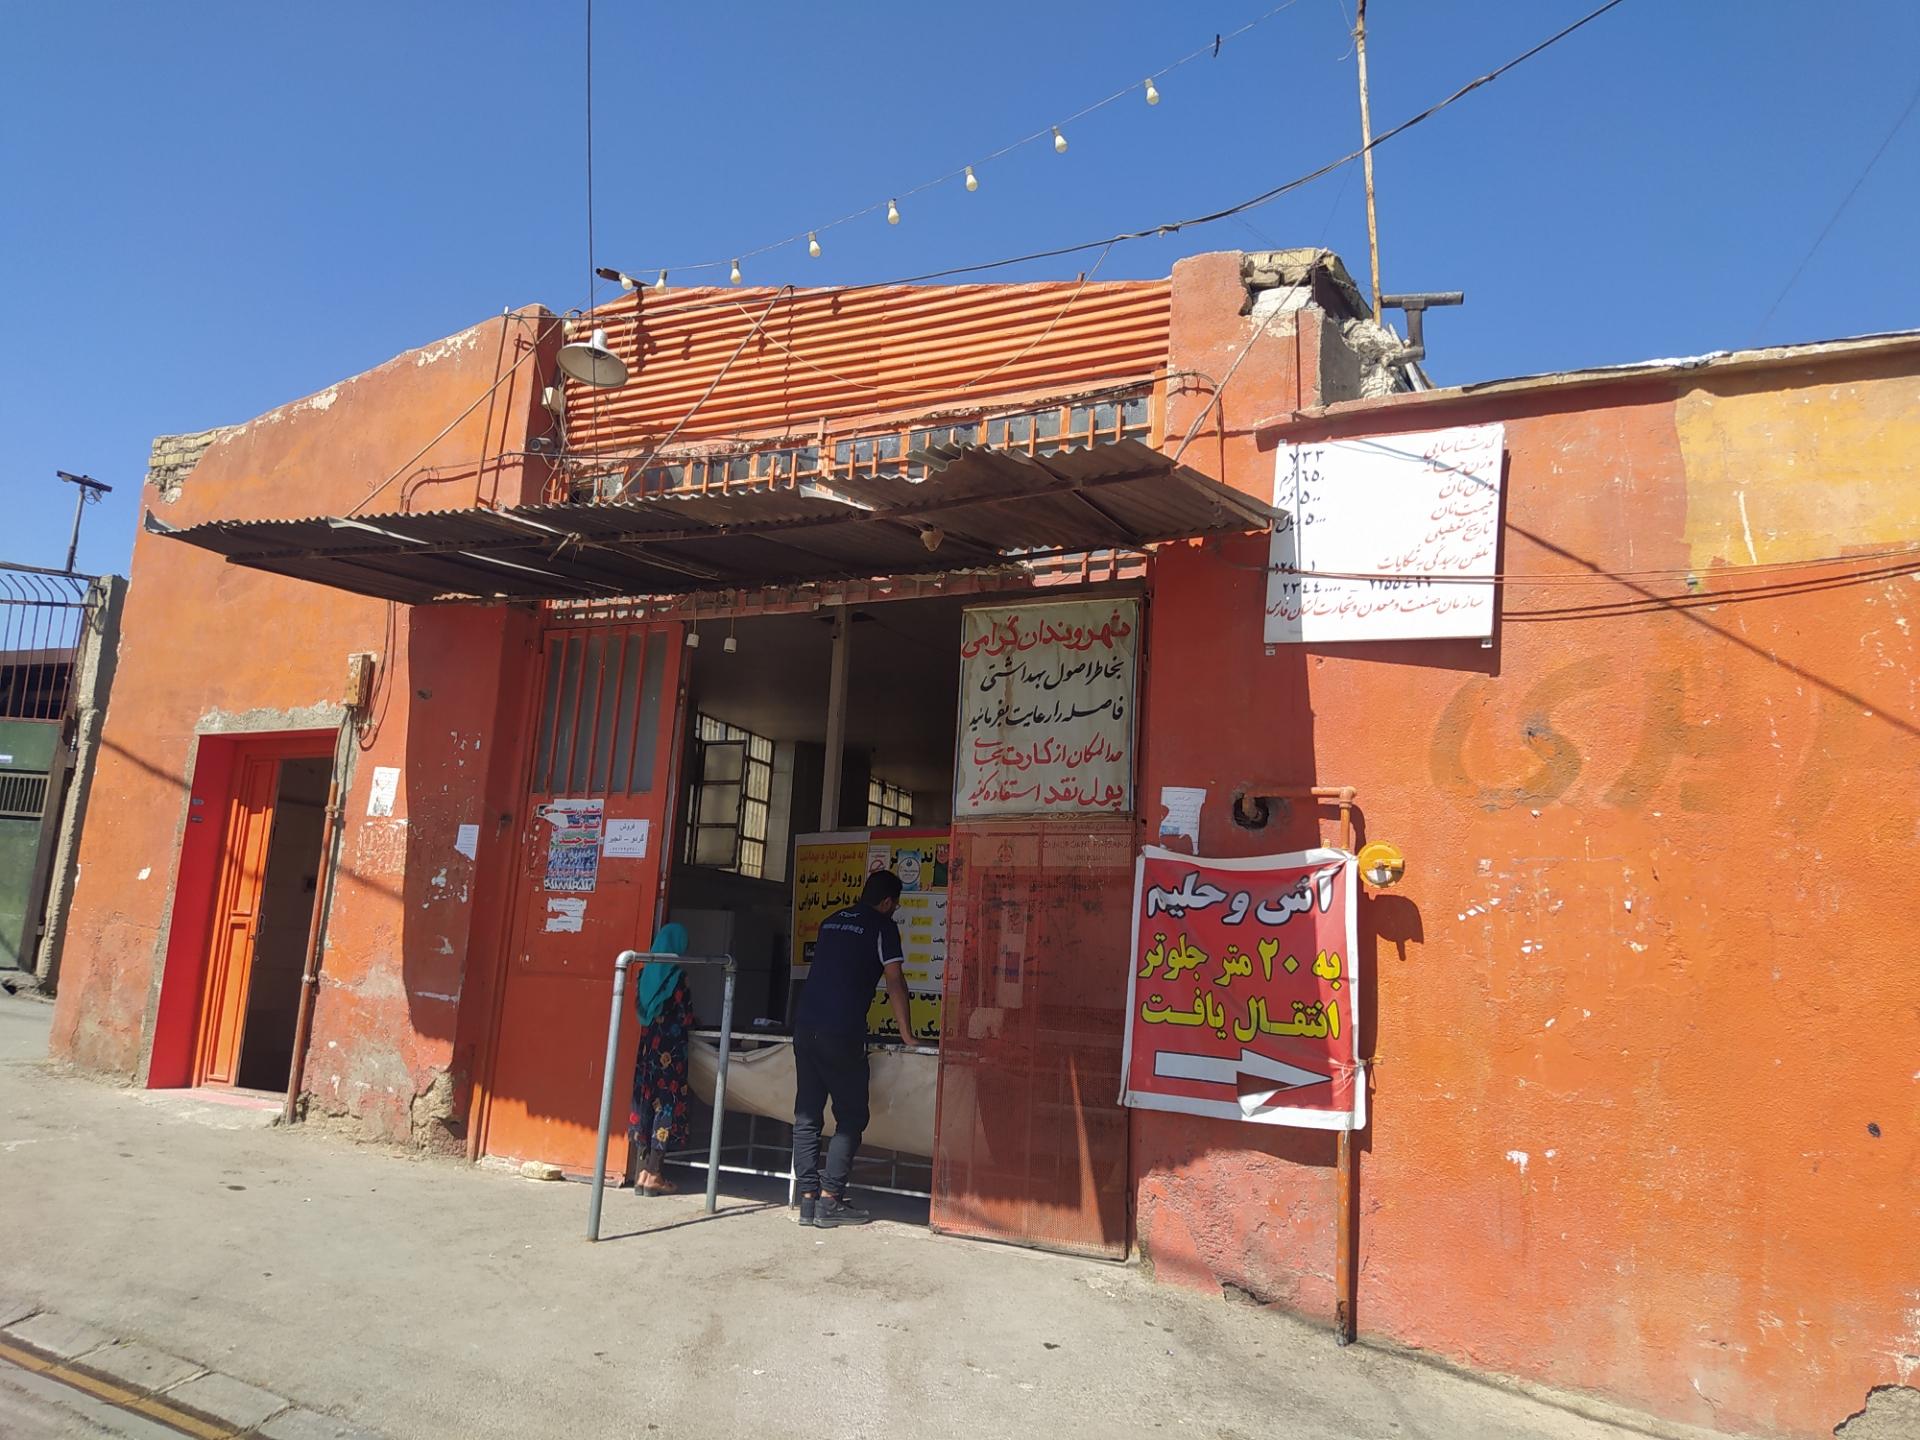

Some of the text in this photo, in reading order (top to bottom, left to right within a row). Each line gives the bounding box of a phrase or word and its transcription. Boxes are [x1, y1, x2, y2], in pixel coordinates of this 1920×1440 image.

[1424, 433, 1484, 459] شناسایی
[1464, 456, 1493, 475] وزن
[1439, 479, 1462, 498] نان
[1275, 513, 1300, 533] ریال
[1431, 501, 1494, 520] قیمت نان
[1425, 518, 1494, 543] تاریخ تعطیلی
[1377, 544, 1421, 572] شکایات
[1424, 545, 1460, 571] رسیدگی
[1458, 542, 1493, 569] تلفن
[1266, 600, 1288, 618] فارس
[1287, 596, 1318, 621] استان
[1313, 596, 1354, 620] تجارت
[1357, 599, 1395, 617] معدن
[1400, 595, 1440, 612] صنعت
[1437, 595, 1483, 614] سازمان
[962, 608, 1131, 658] شهروندان گرامی
[980, 656, 1123, 691] بخاطر اصول بهداشتی
[1007, 705, 1053, 726] رعایت
[1063, 696, 1123, 721] فاصله
[1001, 737, 1054, 770] کارت
[1053, 745, 1066, 763] از
[969, 770, 1123, 814] پول نقد استفاده کنید
[842, 871, 862, 888] ورود
[822, 891, 850, 910] داخل
[1147, 866, 1342, 926] آش و حلیم
[1138, 931, 1342, 990] به ۲۰ متر جلوتر
[1141, 988, 1341, 1042] انتقال یافت
